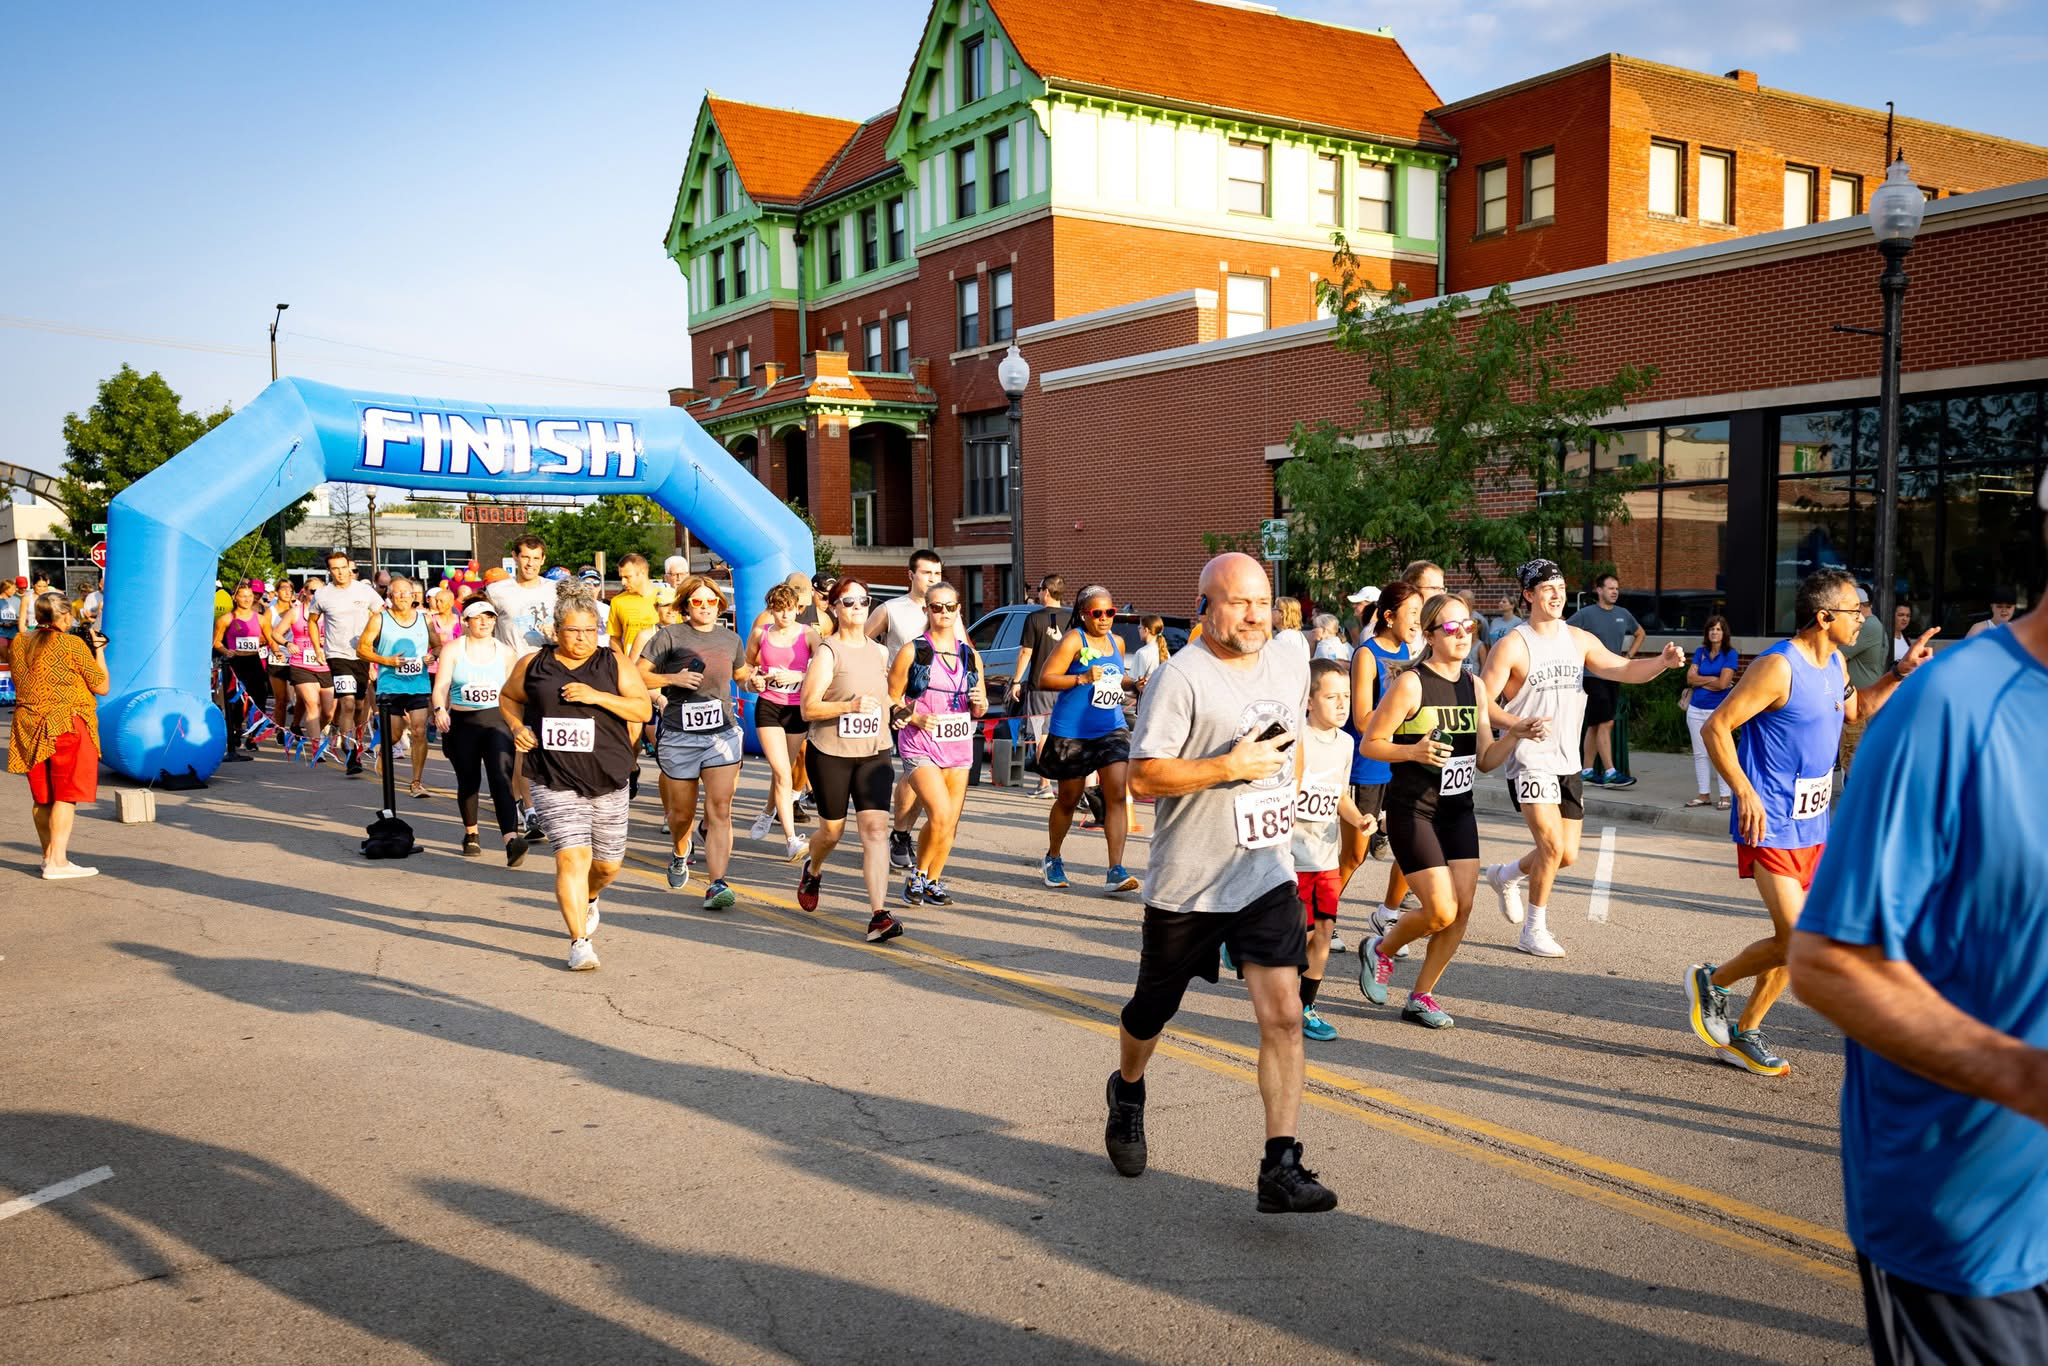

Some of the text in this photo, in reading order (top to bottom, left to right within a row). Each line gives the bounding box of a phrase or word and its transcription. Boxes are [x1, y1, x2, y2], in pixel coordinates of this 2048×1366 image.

[362, 407, 637, 478] FINISH
[93, 549, 107, 561] ST
[238, 641, 257, 650] 1931
[464, 689, 497, 702] 1895
[685, 708, 720, 727] 1977
[843, 717, 879, 734] 1996
[1437, 708, 1476, 732] JUST
[546, 728, 590, 747] 1849
[935, 721, 969, 738] 1880
[1443, 766, 1475, 790] 203
[1297, 790, 1339, 816] 2035
[1798, 787, 1830, 814] 199
